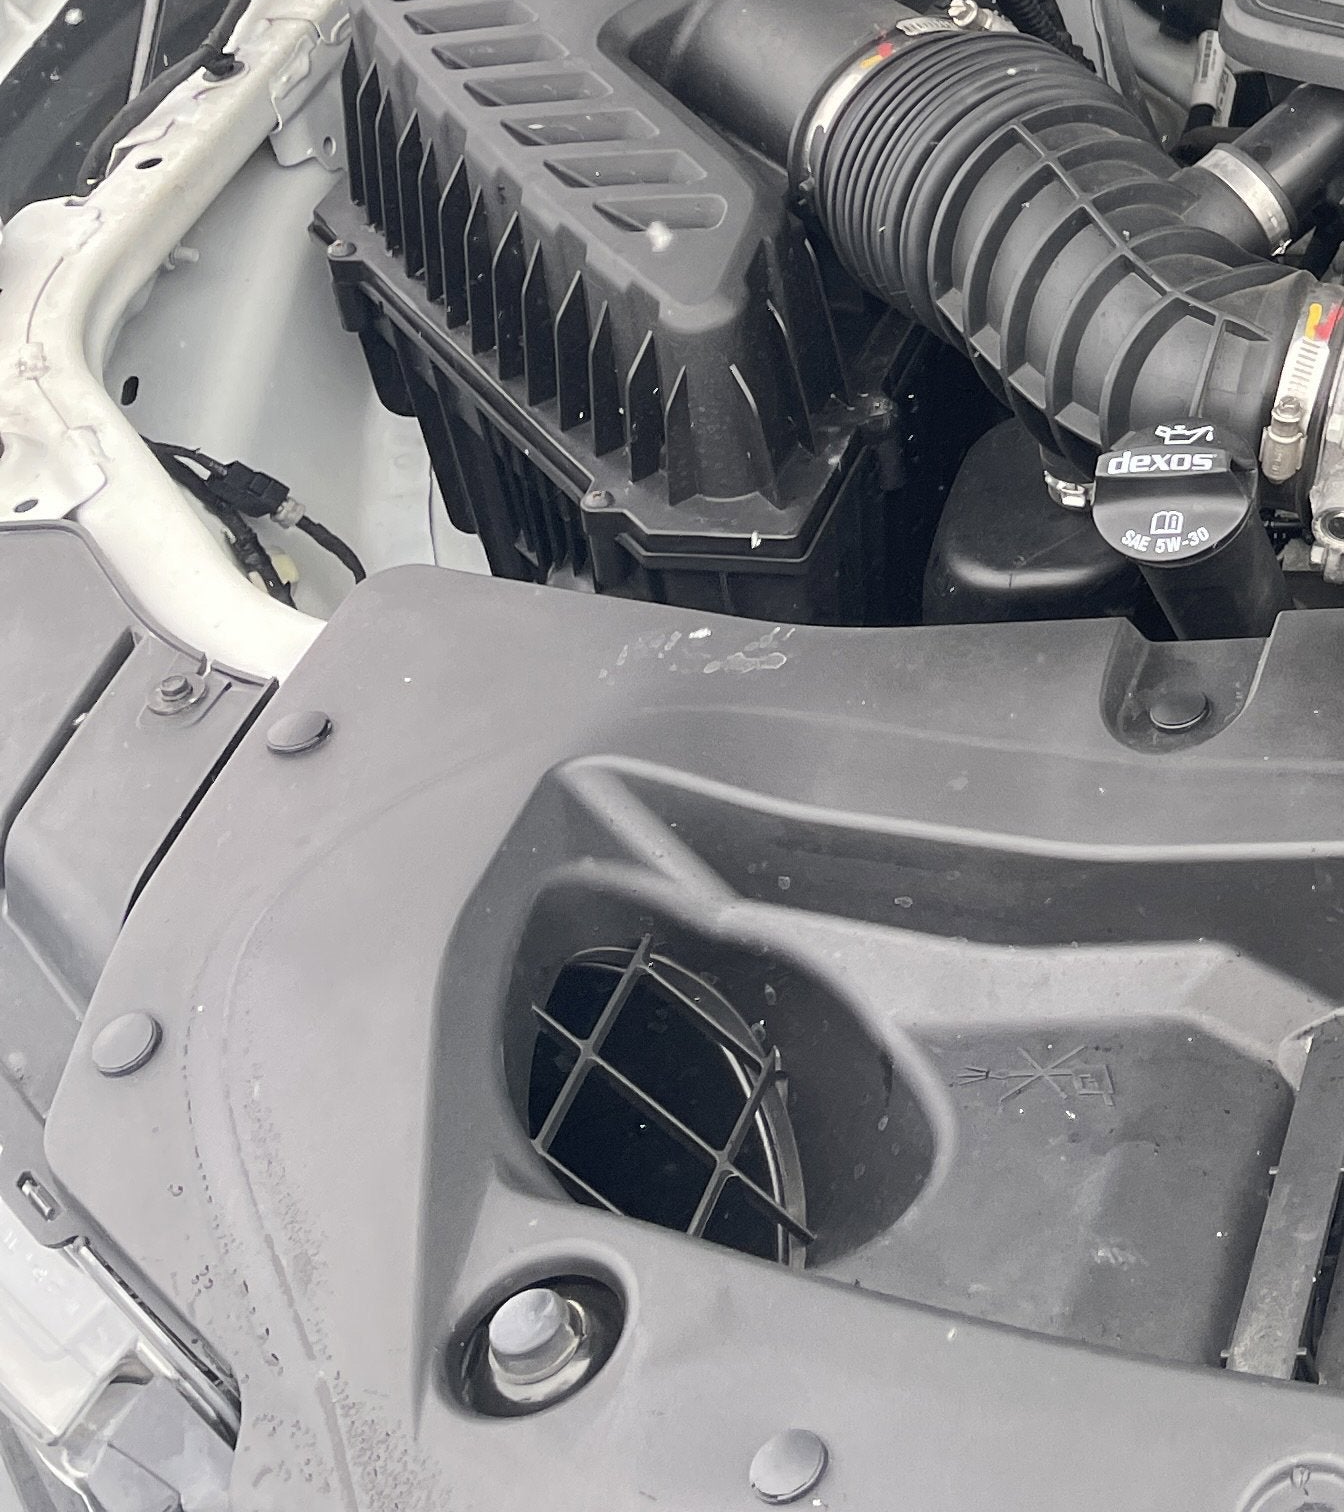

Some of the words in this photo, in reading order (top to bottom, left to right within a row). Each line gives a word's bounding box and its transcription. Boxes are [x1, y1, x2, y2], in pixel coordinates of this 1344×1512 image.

[1107, 451, 1214, 475] dexos
[1121, 529, 1151, 552] SAE
[1155, 526, 1210, 554] 5W-30
